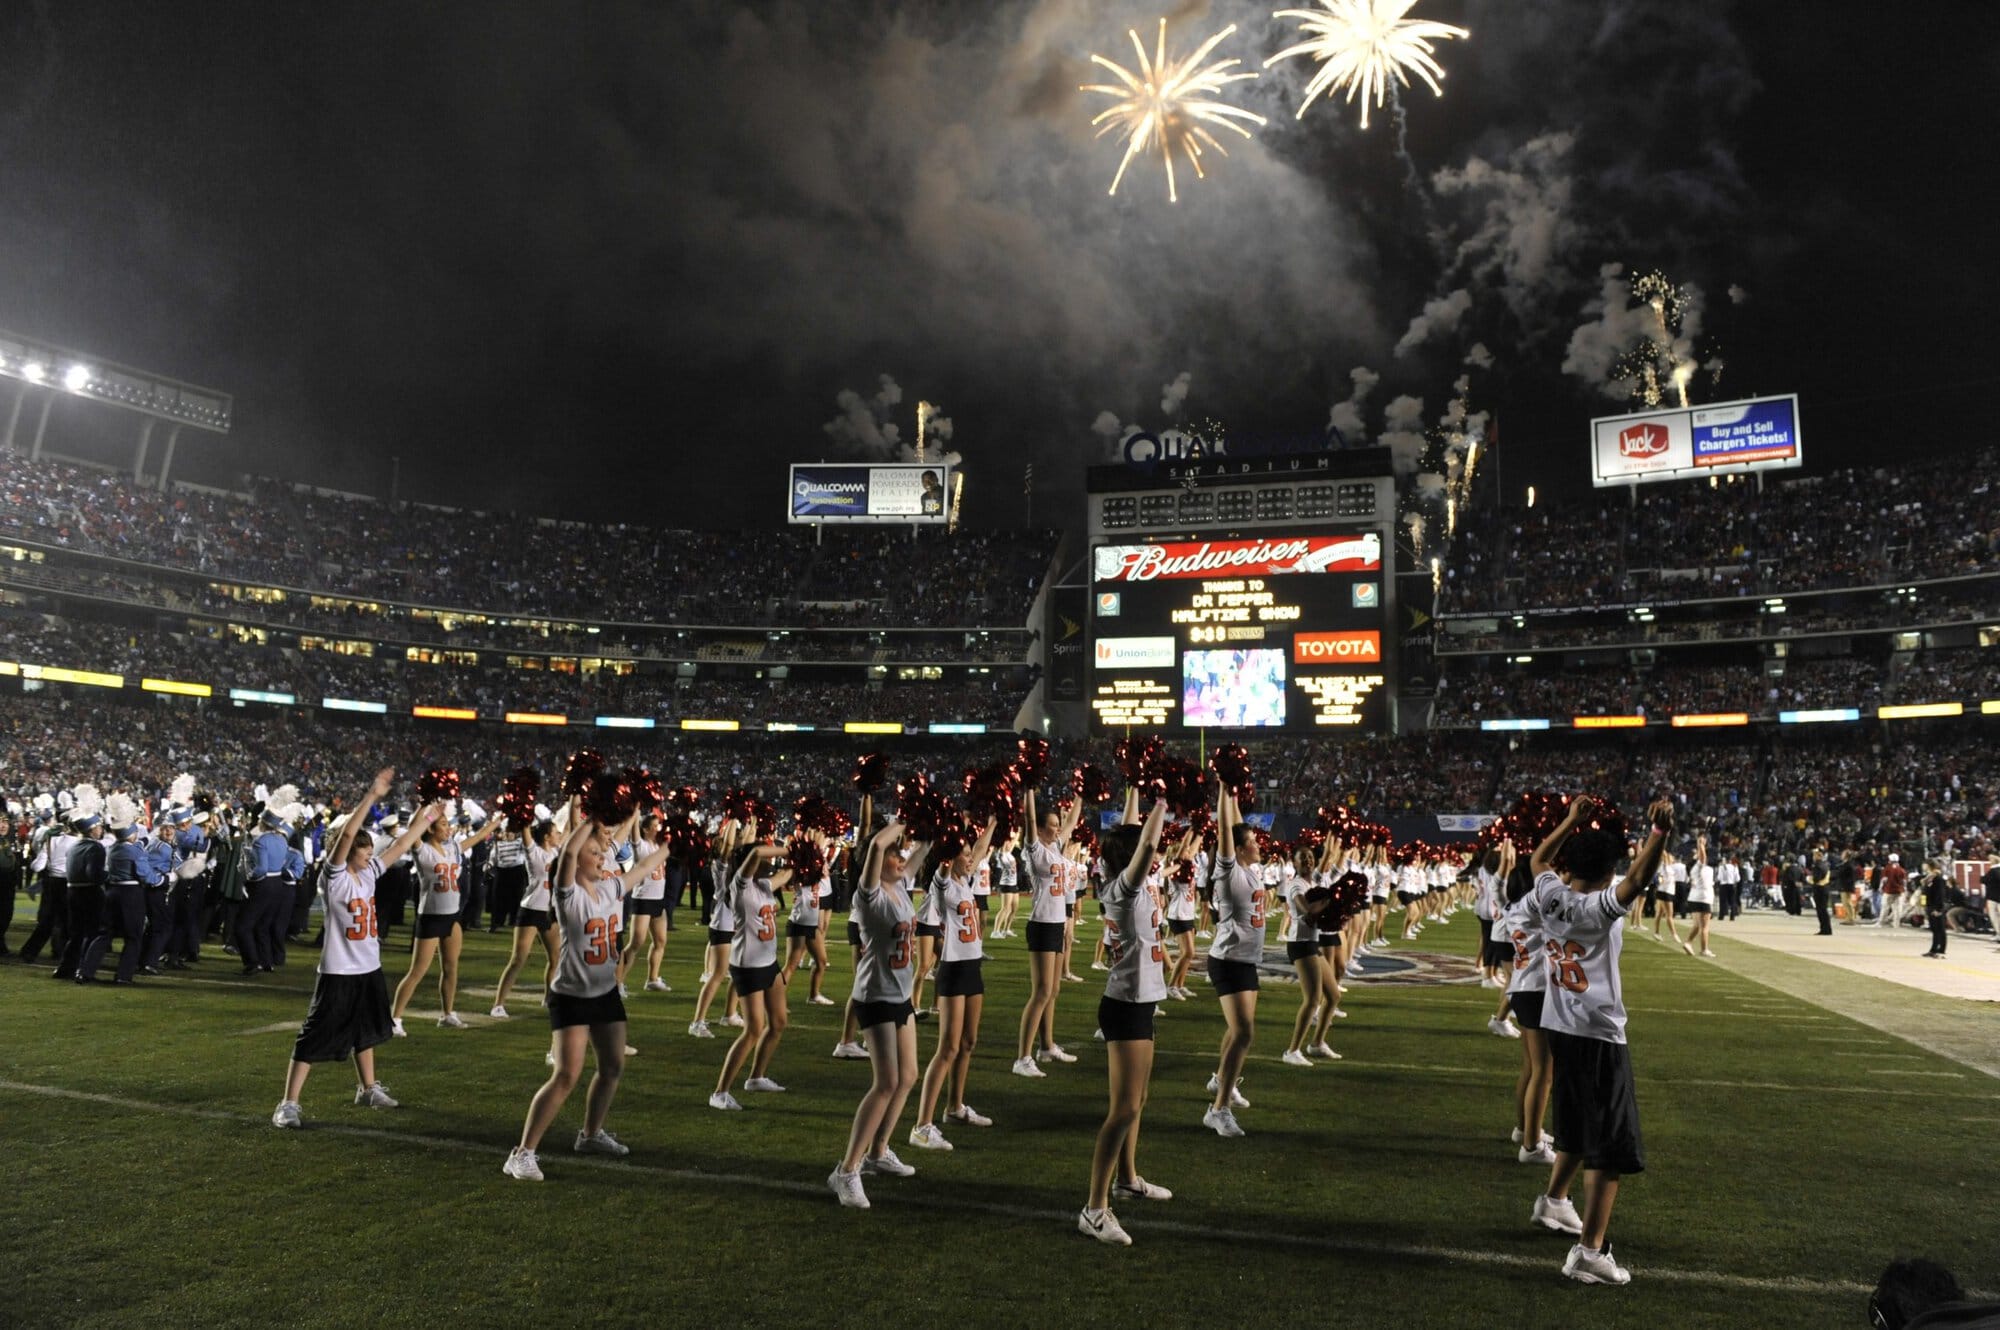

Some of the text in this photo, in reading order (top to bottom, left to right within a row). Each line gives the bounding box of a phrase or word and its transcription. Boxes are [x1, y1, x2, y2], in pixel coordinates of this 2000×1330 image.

[1711, 421, 1774, 438] Buy and Sell
[1621, 425, 1667, 456] Jack
[1699, 432, 1788, 452] Chargers Tickets!
[797, 481, 865, 497] QUALCOMM
[1119, 539, 1310, 581] Budweiser
[1202, 579, 1264, 593] THANKS TO
[1192, 592, 1274, 608] DR PEPPER
[1172, 606, 1300, 623] HALFTIME SHOW
[1297, 639, 1376, 656] TOYOTA
